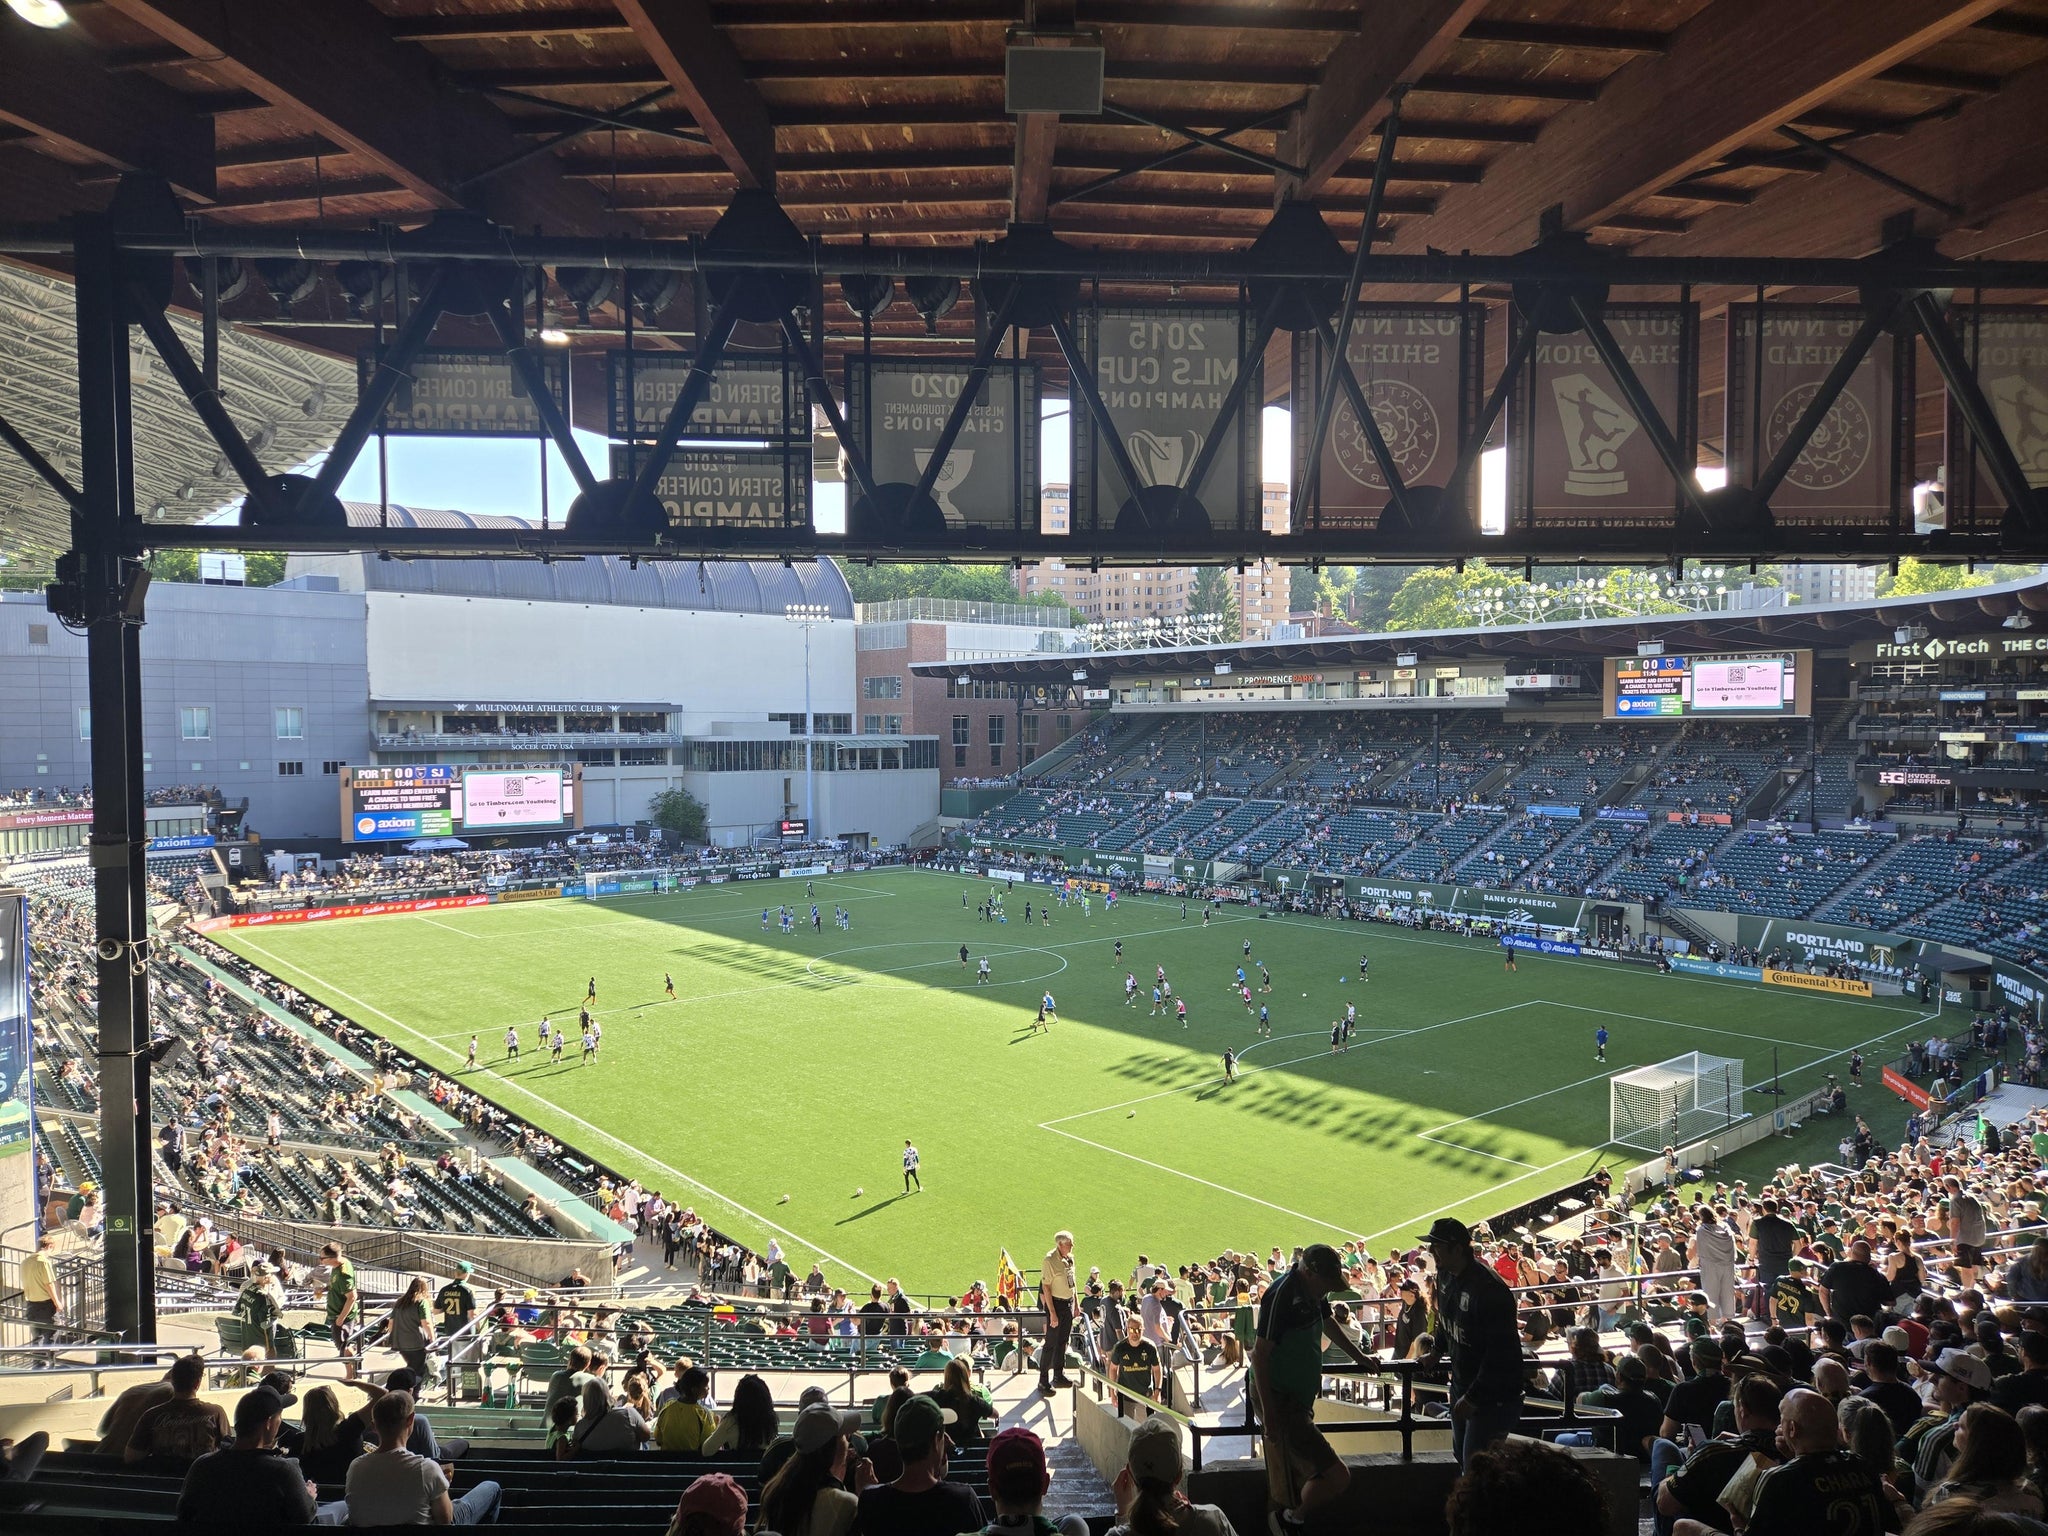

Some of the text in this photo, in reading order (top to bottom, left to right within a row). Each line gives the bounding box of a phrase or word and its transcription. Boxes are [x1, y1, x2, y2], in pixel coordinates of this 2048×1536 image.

[1876, 642, 1920, 657] First
[1947, 639, 1989, 654] Tech
[2002, 640, 2032, 652] THE
[1244, 674, 1314, 685] PROVIDENCE PARK
[476, 703, 603, 712] MULTNOMAH ATHLETIC CLUB
[1632, 700, 1657, 708] axiom
[358, 769, 379, 779] POR
[431, 768, 444, 777] SJ
[16, 816, 35, 825] Every
[36, 815, 66, 823] Moment
[378, 817, 416, 828] axiom
[157, 839, 190, 847] axiom
[503, 888, 558, 901] Continental Tire
[1361, 887, 1412, 900] PORTLAND
[1484, 894, 1557, 908] BANK OF AMERICA
[1513, 939, 1577, 955] Allstate Allstate
[1786, 932, 1865, 953] PORTLAND
[1803, 946, 1849, 959] TIMBERS
[1771, 970, 1865, 993] Continental Tire
[1996, 973, 2034, 1001] PORTLAND
[1864, 1174, 1875, 1184] 21
[444, 1298, 461, 1315] 21
[1777, 1291, 1800, 1314] 29
